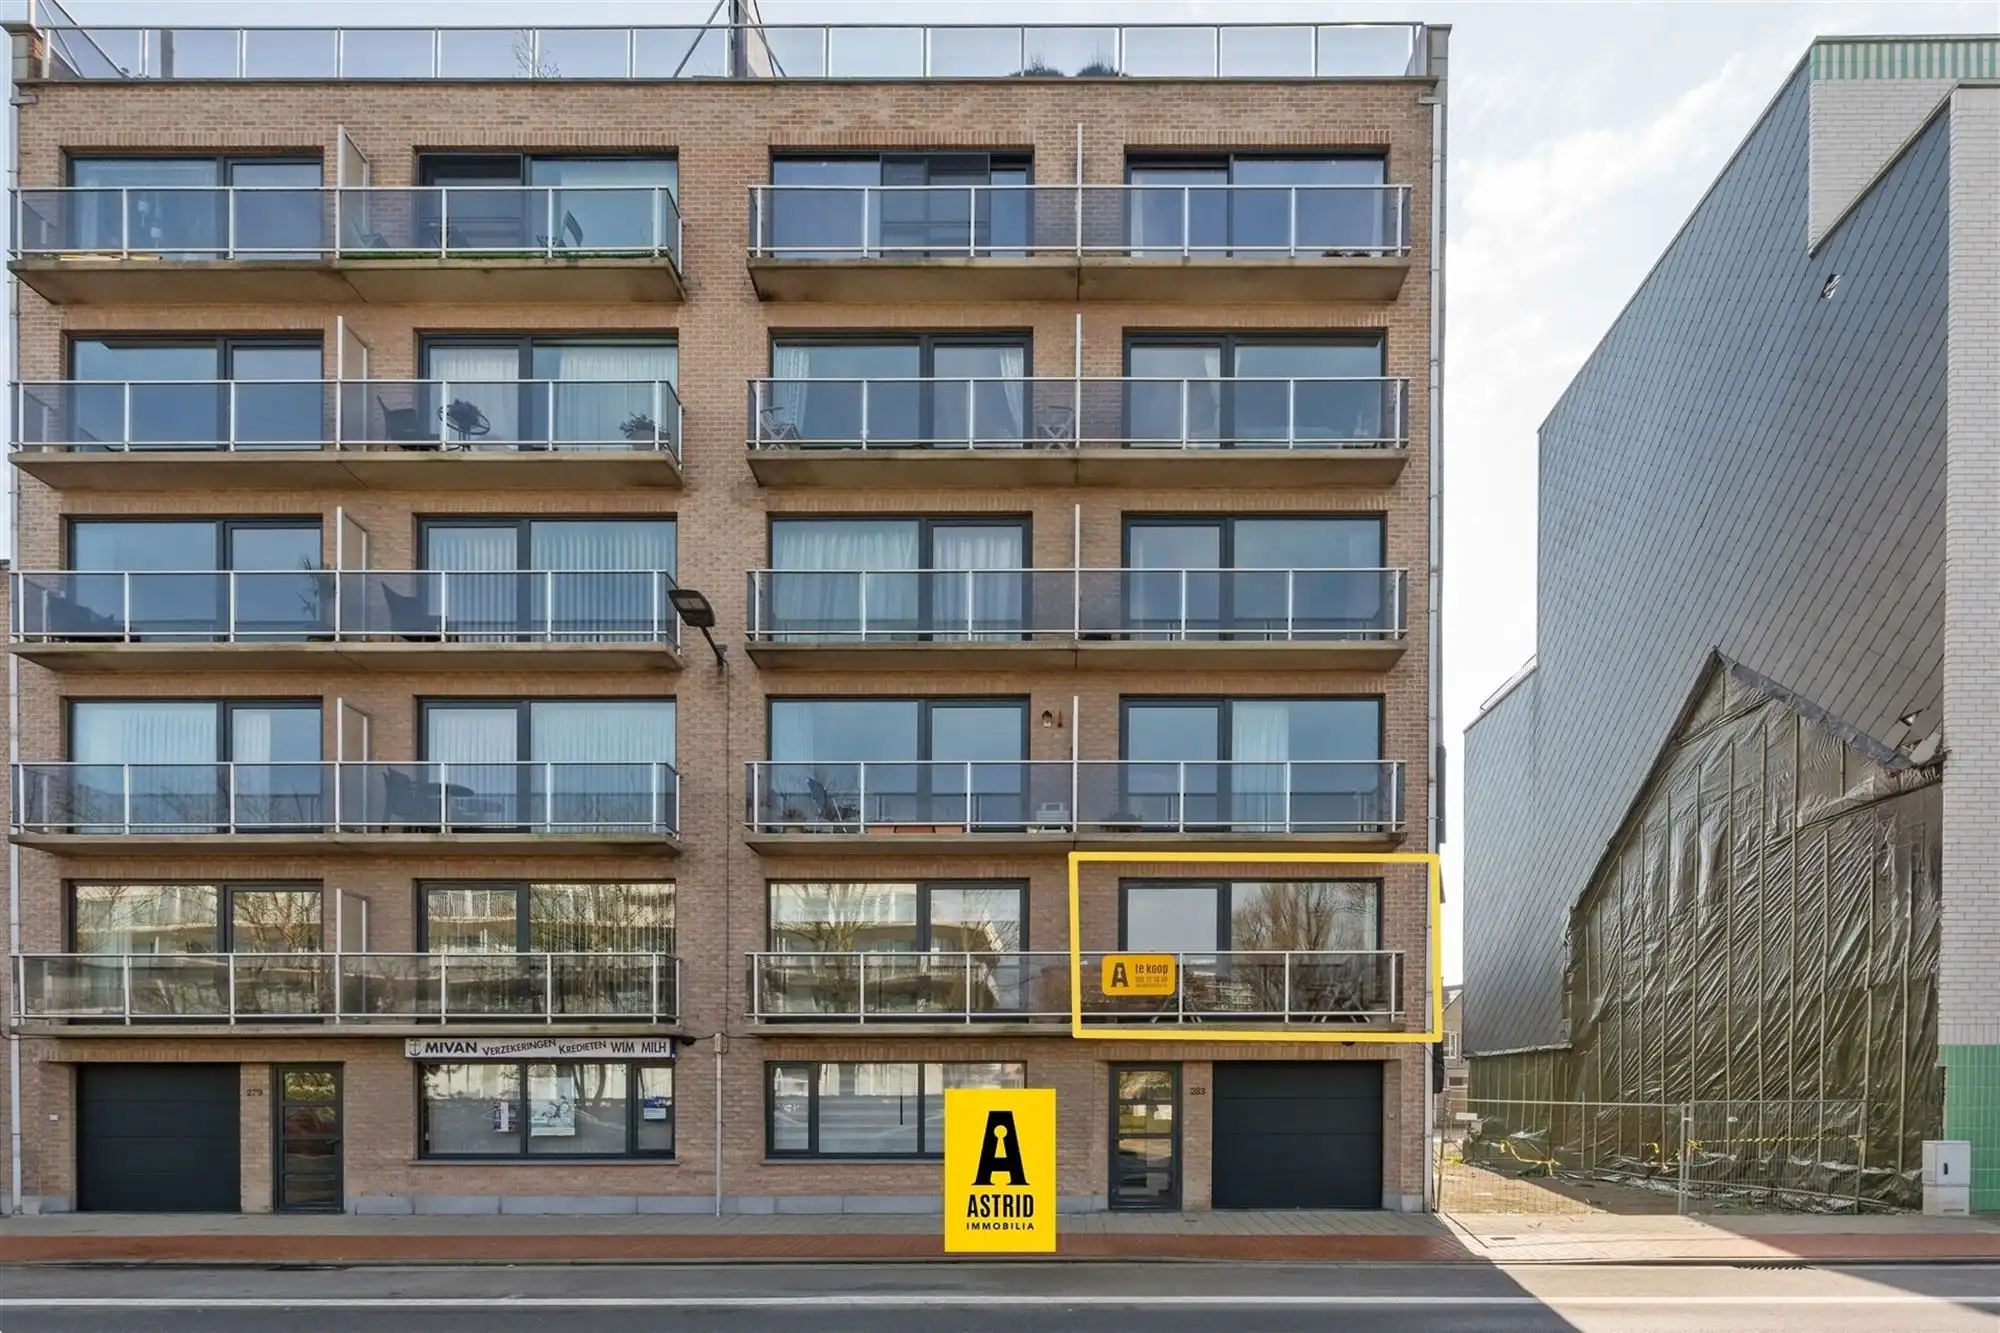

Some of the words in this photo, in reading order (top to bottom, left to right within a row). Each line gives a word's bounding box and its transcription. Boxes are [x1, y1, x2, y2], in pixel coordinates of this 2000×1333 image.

[1146, 964, 1168, 975] koop
[425, 1042, 477, 1054] MIVAN
[482, 1039, 557, 1056] VERZEKERINGEN
[558, 1040, 607, 1054] KREDIETEN
[610, 1042, 635, 1053] WIM
[641, 1042, 666, 1053] MILH
[1190, 1087, 1206, 1096] 283
